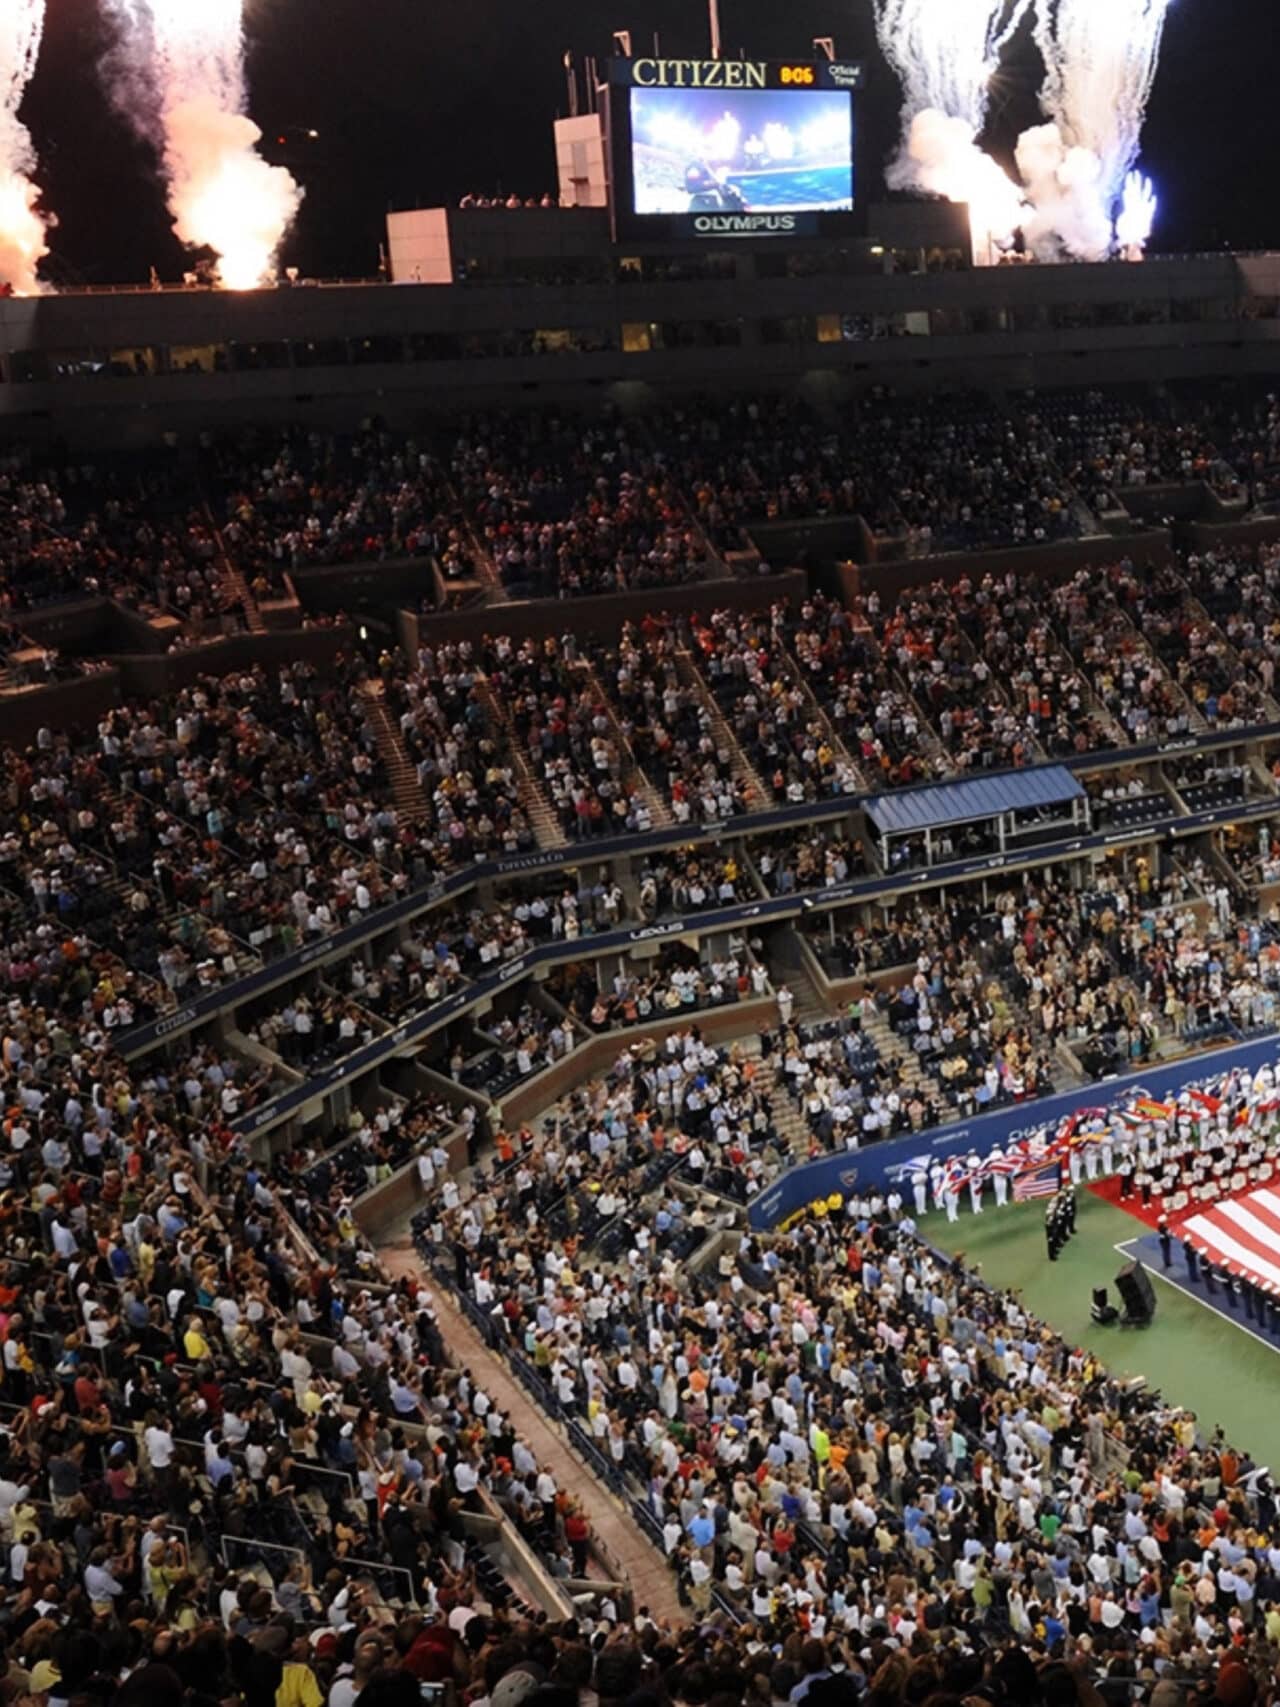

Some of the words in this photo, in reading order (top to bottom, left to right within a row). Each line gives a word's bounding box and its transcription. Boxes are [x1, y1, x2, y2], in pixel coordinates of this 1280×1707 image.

[632, 59, 767, 88] CITIZEN
[694, 215, 796, 231] OLYMPUS
[630, 922, 684, 940] LEXUS
